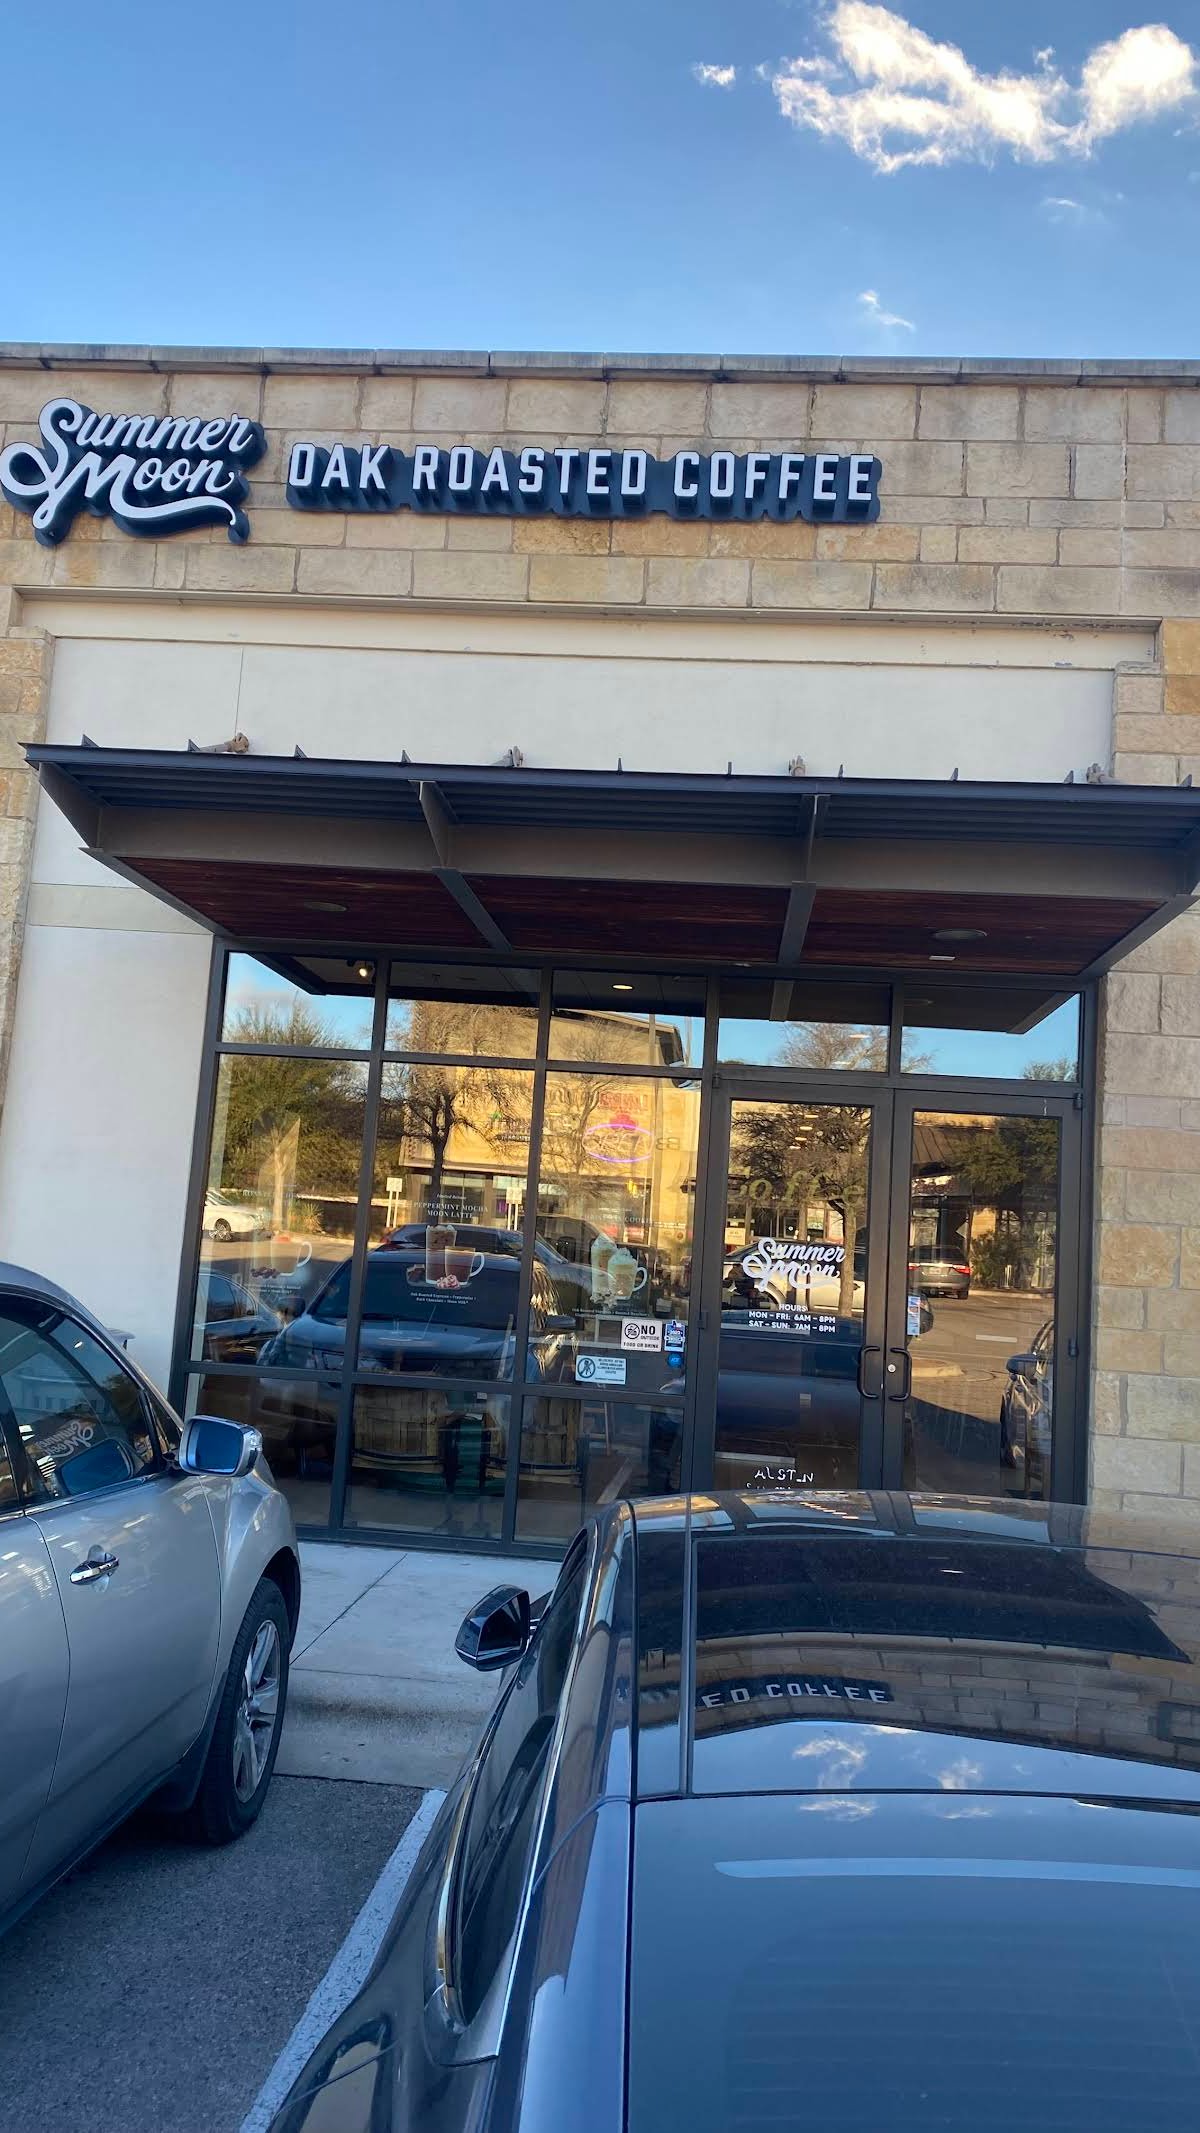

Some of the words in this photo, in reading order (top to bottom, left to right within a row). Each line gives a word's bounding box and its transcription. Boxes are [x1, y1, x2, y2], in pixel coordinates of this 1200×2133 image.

[0, 397, 253, 490] Summer
[288, 443, 390, 488] OAK
[412, 445, 647, 495] ROASTED
[674, 450, 874, 501] COFFEE
[33, 452, 236, 529] Moon
[414, 1202, 460, 1211] PEPPERMINT
[427, 1209, 449, 1217] MOON
[451, 1211, 473, 1219] LATTE
[743, 1237, 846, 1278] Summer
[757, 1259, 840, 1292] Moon
[778, 1304, 808, 1312] HOURS
[748, 1311, 768, 1319] MON
[641, 1325, 656, 1335] NO
[794, 1323, 811, 1331] 7AM
